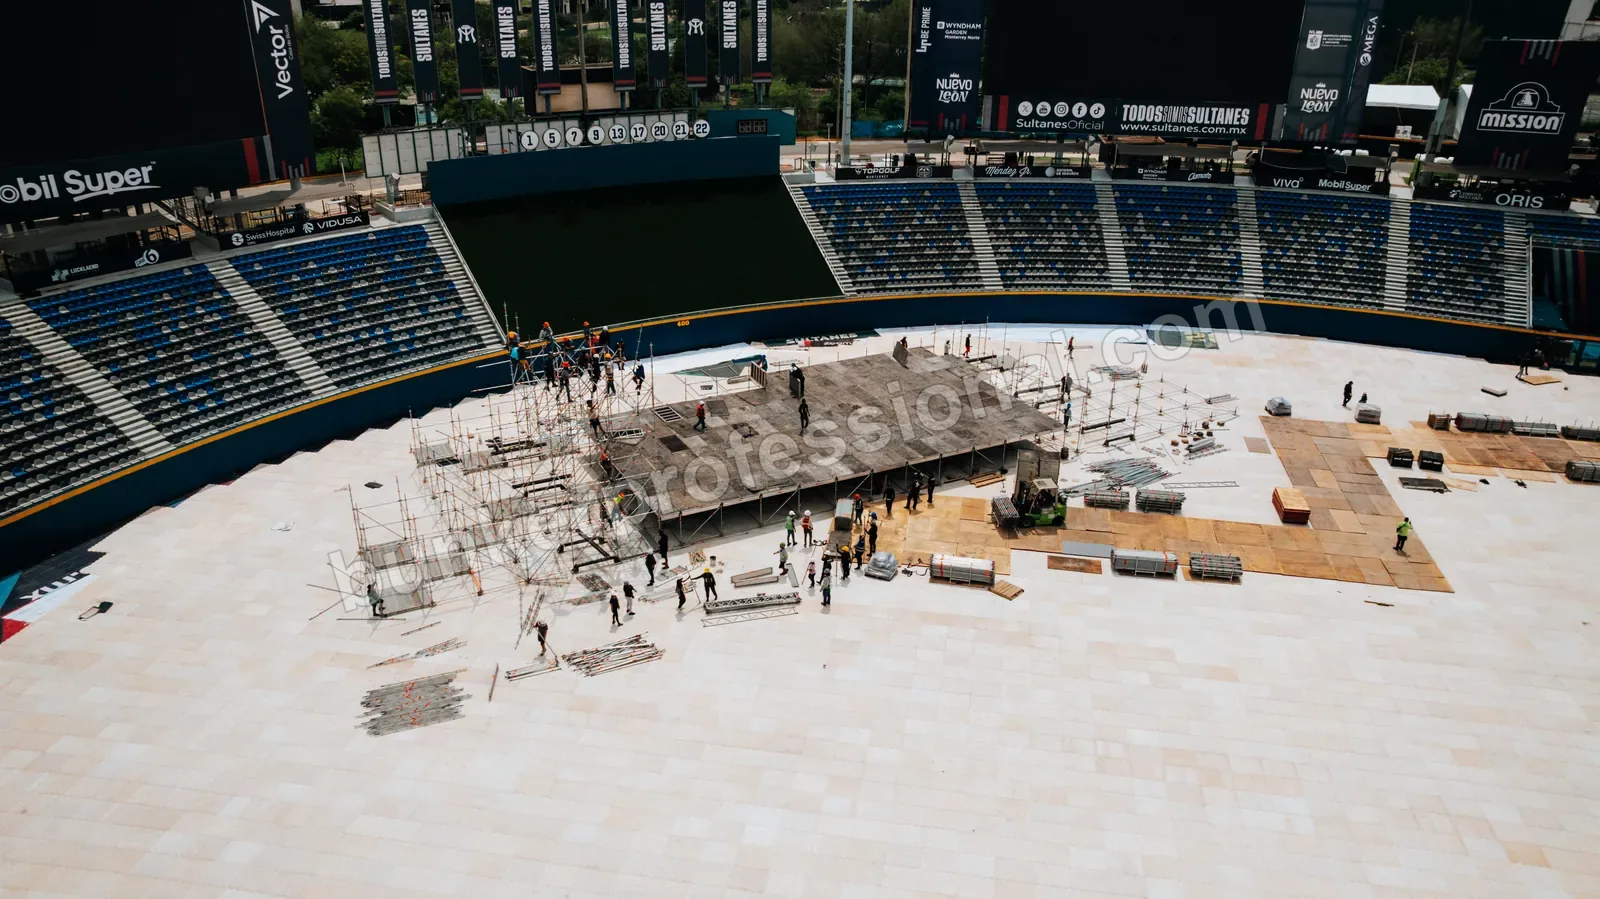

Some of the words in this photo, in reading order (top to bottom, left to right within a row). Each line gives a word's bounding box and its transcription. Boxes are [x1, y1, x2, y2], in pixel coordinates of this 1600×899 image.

[650, 2, 666, 51] SULTANES
[722, 1, 737, 48] SULTANES
[921, 6, 931, 29] PRIME
[945, 22, 981, 30] WYNDHAM
[411, 8, 432, 62] SULTANES
[498, 6, 516, 58] SULTANES
[269, 25, 294, 99] Vector
[527, 135, 533, 146] 1
[549, 133, 556, 143] 5
[571, 131, 577, 142] 7
[593, 130, 599, 140] 9
[612, 128, 624, 139] 13
[633, 127, 645, 138] 17
[654, 126, 666, 136] 20
[675, 125, 687, 135] 21
[695, 123, 708, 134] 22
[1120, 123, 1247, 134] www.sultanes.com.mx
[63, 164, 153, 196] Super
[1495, 193, 1544, 209] ORIS
[317, 215, 362, 229] VIDUSA
